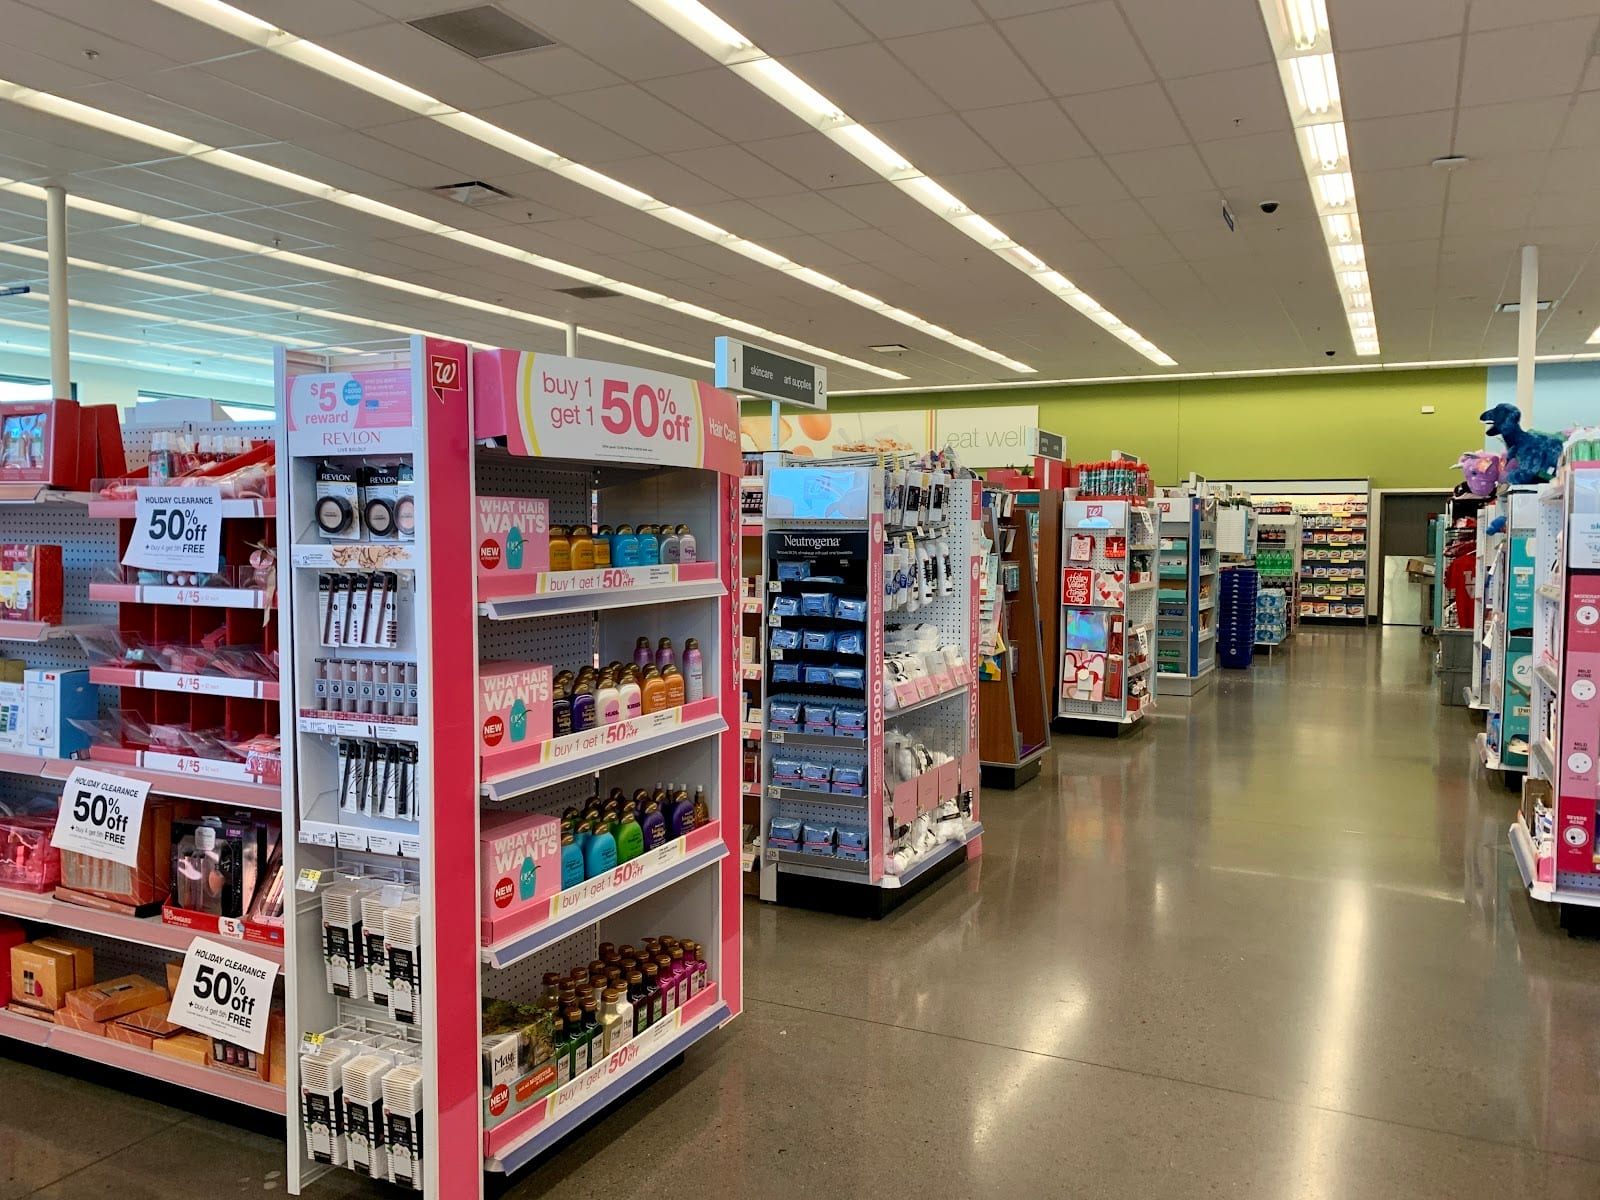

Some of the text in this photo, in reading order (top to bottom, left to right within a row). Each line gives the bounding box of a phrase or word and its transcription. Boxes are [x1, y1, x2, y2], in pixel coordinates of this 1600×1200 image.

[732, 357, 736, 372] 1
[750, 364, 774, 380] skincare
[542, 372, 592, 401] buy 1
[784, 375, 812, 390] art supplies
[818, 381, 823, 395] 2
[310, 382, 336, 412] $5
[306, 410, 348, 424] reward
[550, 405, 594, 429] get 1
[600, 378, 676, 438] 50%
[322, 430, 382, 446] REVLON
[708, 418, 738, 443] Hair Care
[948, 427, 980, 448] eat
[986, 424, 1026, 448] well
[322, 474, 350, 482] REVLON
[370, 476, 398, 484] REVLON
[145, 496, 214, 504] HOLIDAY CLEARANCE
[480, 500, 544, 514] WHAT HAIR
[149, 508, 198, 540] 50%
[185, 524, 208, 541] off
[480, 514, 546, 534] WANTS
[182, 544, 206, 554] FREE
[784, 534, 840, 550] Neutrogena
[480, 547, 500, 556] NEW
[550, 577, 568, 592] buy
[570, 576, 576, 590] 1
[177, 590, 200, 604] 4/$5
[874, 620, 882, 676] points
[177, 678, 200, 690] 4/$5
[484, 670, 548, 692] WHAT HAIR
[484, 682, 548, 712] WANTS
[873, 680, 882, 737] 5000
[484, 722, 502, 735] NEW
[554, 744, 573, 758] buy
[575, 738, 580, 751] 1
[177, 758, 200, 773] 4/$5
[74, 776, 140, 798] HOLIDAY CLEARANCE
[73, 790, 120, 826] 50%
[106, 814, 128, 832] off
[104, 831, 126, 845] FREE
[495, 822, 557, 854] WHAT HAIR
[495, 835, 558, 874] WANTS
[495, 884, 513, 898] NEW
[562, 893, 581, 908] buy
[584, 888, 588, 898] 1
[590, 880, 606, 896] get
[224, 920, 234, 932] $5
[194, 948, 267, 980] HOLIDAY CLEARANCE
[194, 964, 246, 1006] 50%
[231, 996, 256, 1016] off
[194, 1003, 204, 1012] buy
[209, 1007, 218, 1016] get
[227, 1012, 252, 1029] FREE
[558, 1086, 576, 1105] buy
[586, 1068, 601, 1090] get
[490, 1089, 508, 1107] NEW
